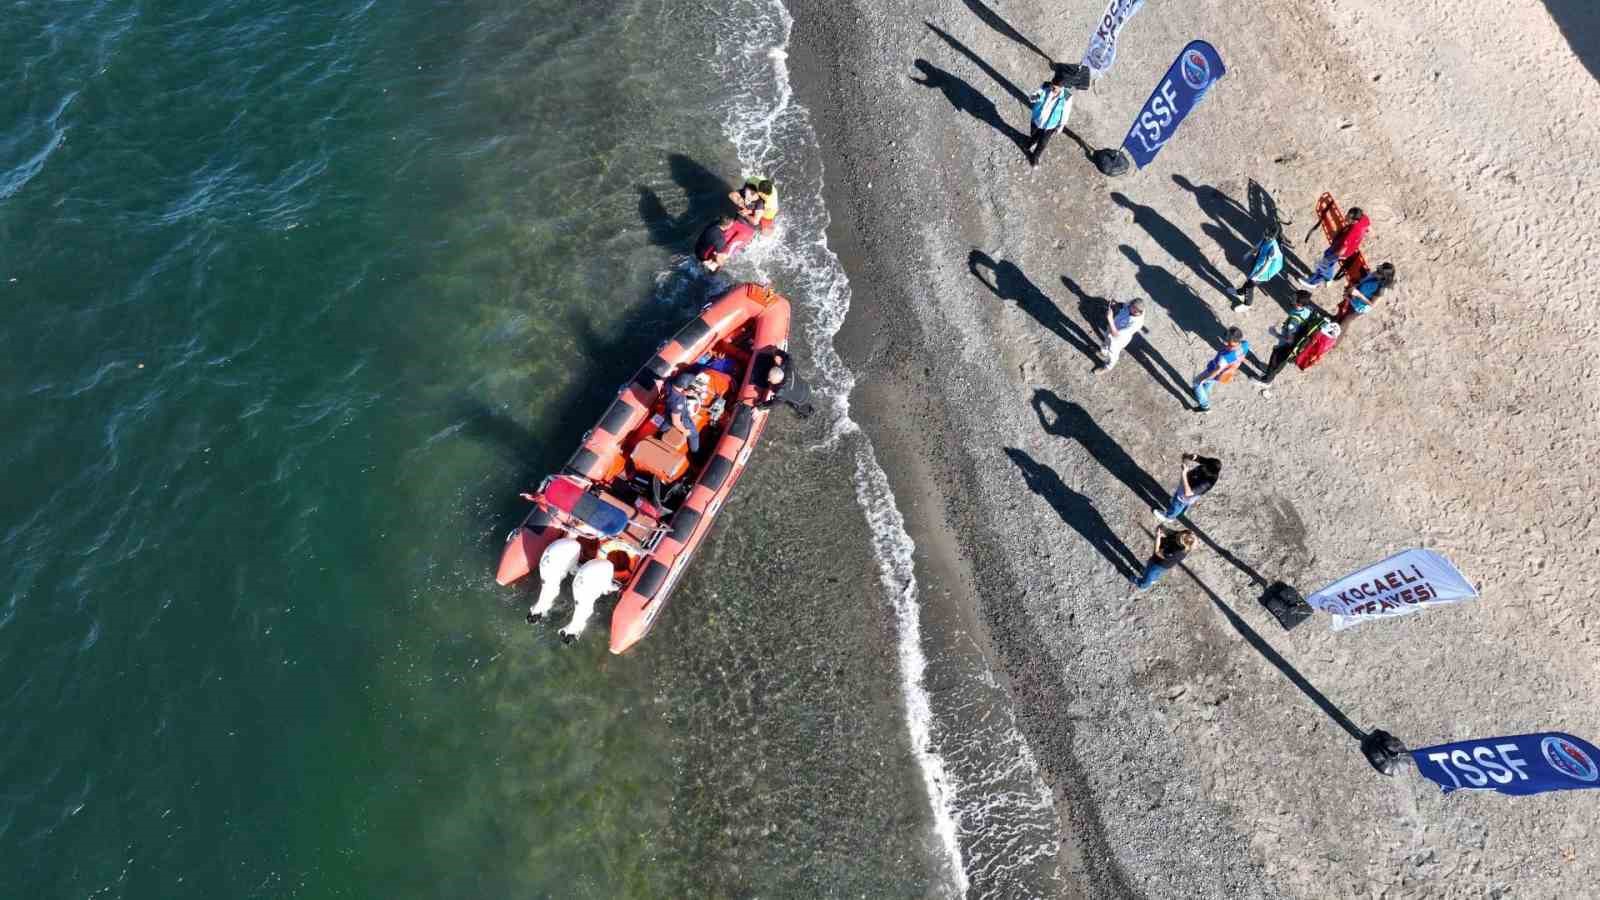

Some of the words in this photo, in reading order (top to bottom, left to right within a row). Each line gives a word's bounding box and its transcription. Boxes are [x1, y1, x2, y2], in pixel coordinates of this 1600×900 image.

[1131, 79, 1179, 152] TSSF
[1337, 564, 1424, 606] KOCAELİ
[1428, 743, 1529, 788] TSSF
